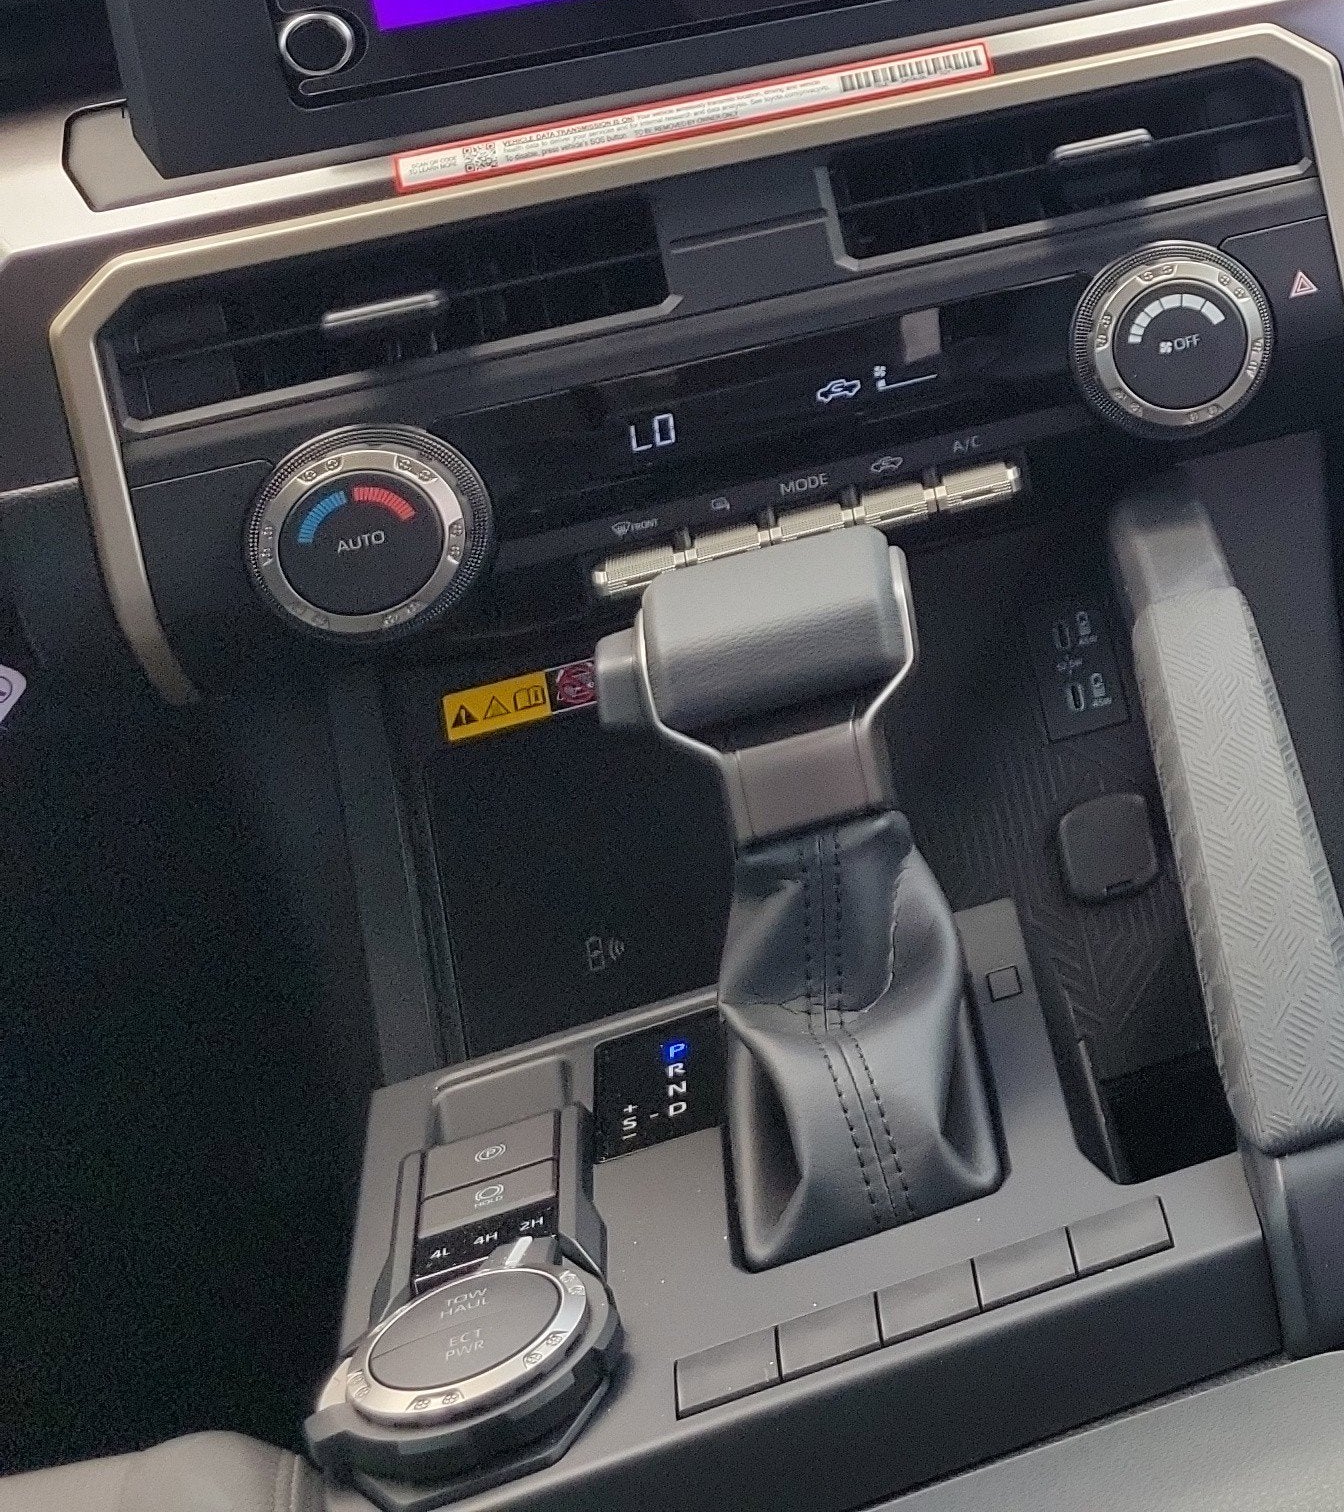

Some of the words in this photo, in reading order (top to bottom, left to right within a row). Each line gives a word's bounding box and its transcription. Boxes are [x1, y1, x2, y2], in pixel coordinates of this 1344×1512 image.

[1173, 334, 1201, 351] OFF
[952, 435, 981, 454] A/C
[779, 471, 829, 496] MODE
[337, 530, 386, 554] AUTO
[669, 1043, 686, 1060] P
[667, 1062, 686, 1079] R
[668, 1080, 687, 1097] N
[668, 1101, 687, 1117] D
[429, 1247, 451, 1260] 4L
[473, 1231, 499, 1246] 4H
[519, 1216, 545, 1232] 2H
[445, 1287, 488, 1307] TOW
[439, 1297, 490, 1319] HAUL
[449, 1328, 484, 1346] ECT
[444, 1339, 486, 1362] PWR
